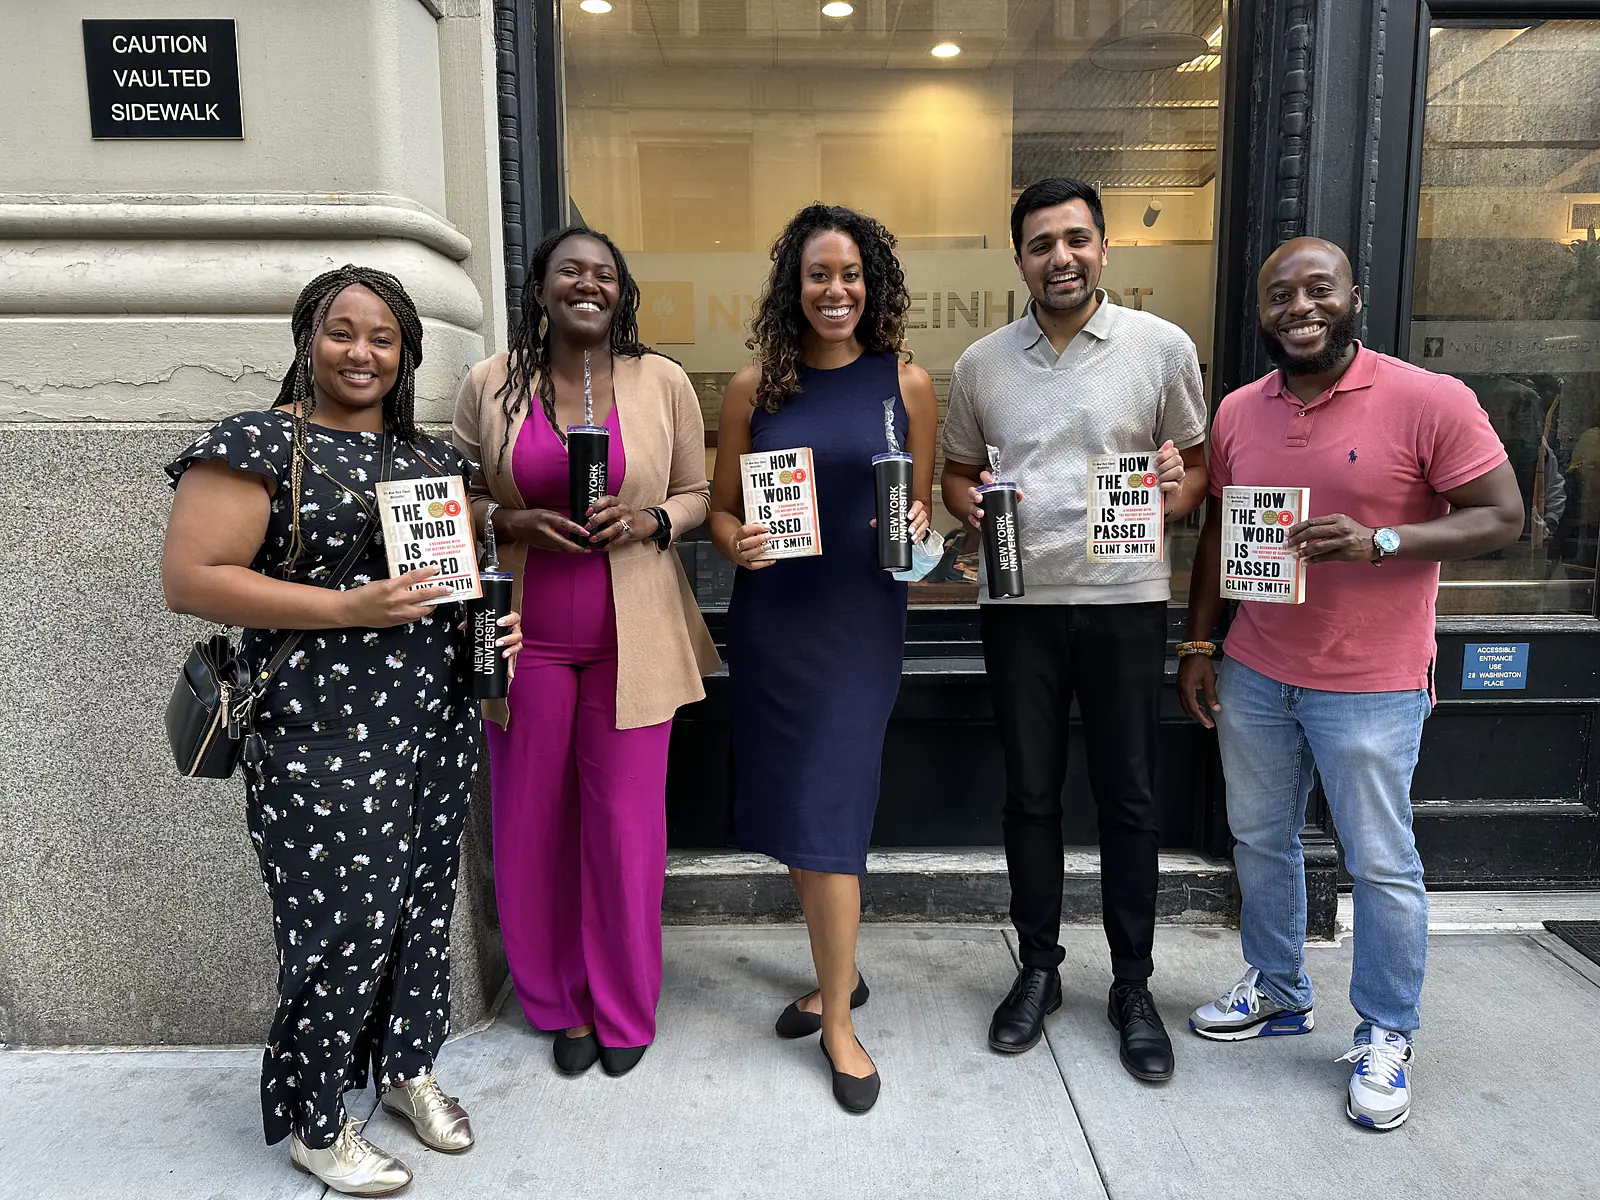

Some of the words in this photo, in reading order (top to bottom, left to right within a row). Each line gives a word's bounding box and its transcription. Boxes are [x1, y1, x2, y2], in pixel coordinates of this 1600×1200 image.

[112, 36, 207, 53] CAUTION
[113, 70, 211, 87] VAULTED
[111, 103, 220, 121] SIDEWALK
[770, 453, 796, 470] HOW
[1120, 456, 1149, 472] HOW
[588, 464, 598, 494] YORK
[751, 472, 774, 488] THE
[1097, 475, 1122, 490] THE
[415, 482, 448, 501] HOW
[764, 486, 800, 503] WORD
[1109, 490, 1149, 506] WORD
[890, 486, 899, 519] YORK
[1254, 493, 1285, 508] HOW
[391, 504, 422, 522] THE
[758, 506, 771, 520] IS
[1102, 508, 1115, 522] IS
[1231, 509, 1256, 525] THE
[409, 520, 455, 540] WORD
[768, 518, 801, 534] SSED
[890, 521, 899, 541] NEW
[996, 514, 1006, 546] YORK
[1094, 524, 1145, 539] PASSED
[784, 537, 812, 548] SMITH
[1243, 527, 1284, 543] WORD
[404, 543, 421, 560] IS
[1093, 544, 1120, 554] CLINT
[1125, 543, 1155, 553] SMITH
[1235, 543, 1248, 558] IS
[999, 547, 1010, 570] NEW
[1227, 560, 1280, 577] PASSED
[1226, 580, 1253, 591] CLINT
[1258, 582, 1290, 593] SMITH
[475, 611, 484, 643] YORK
[474, 646, 483, 672] NEW
